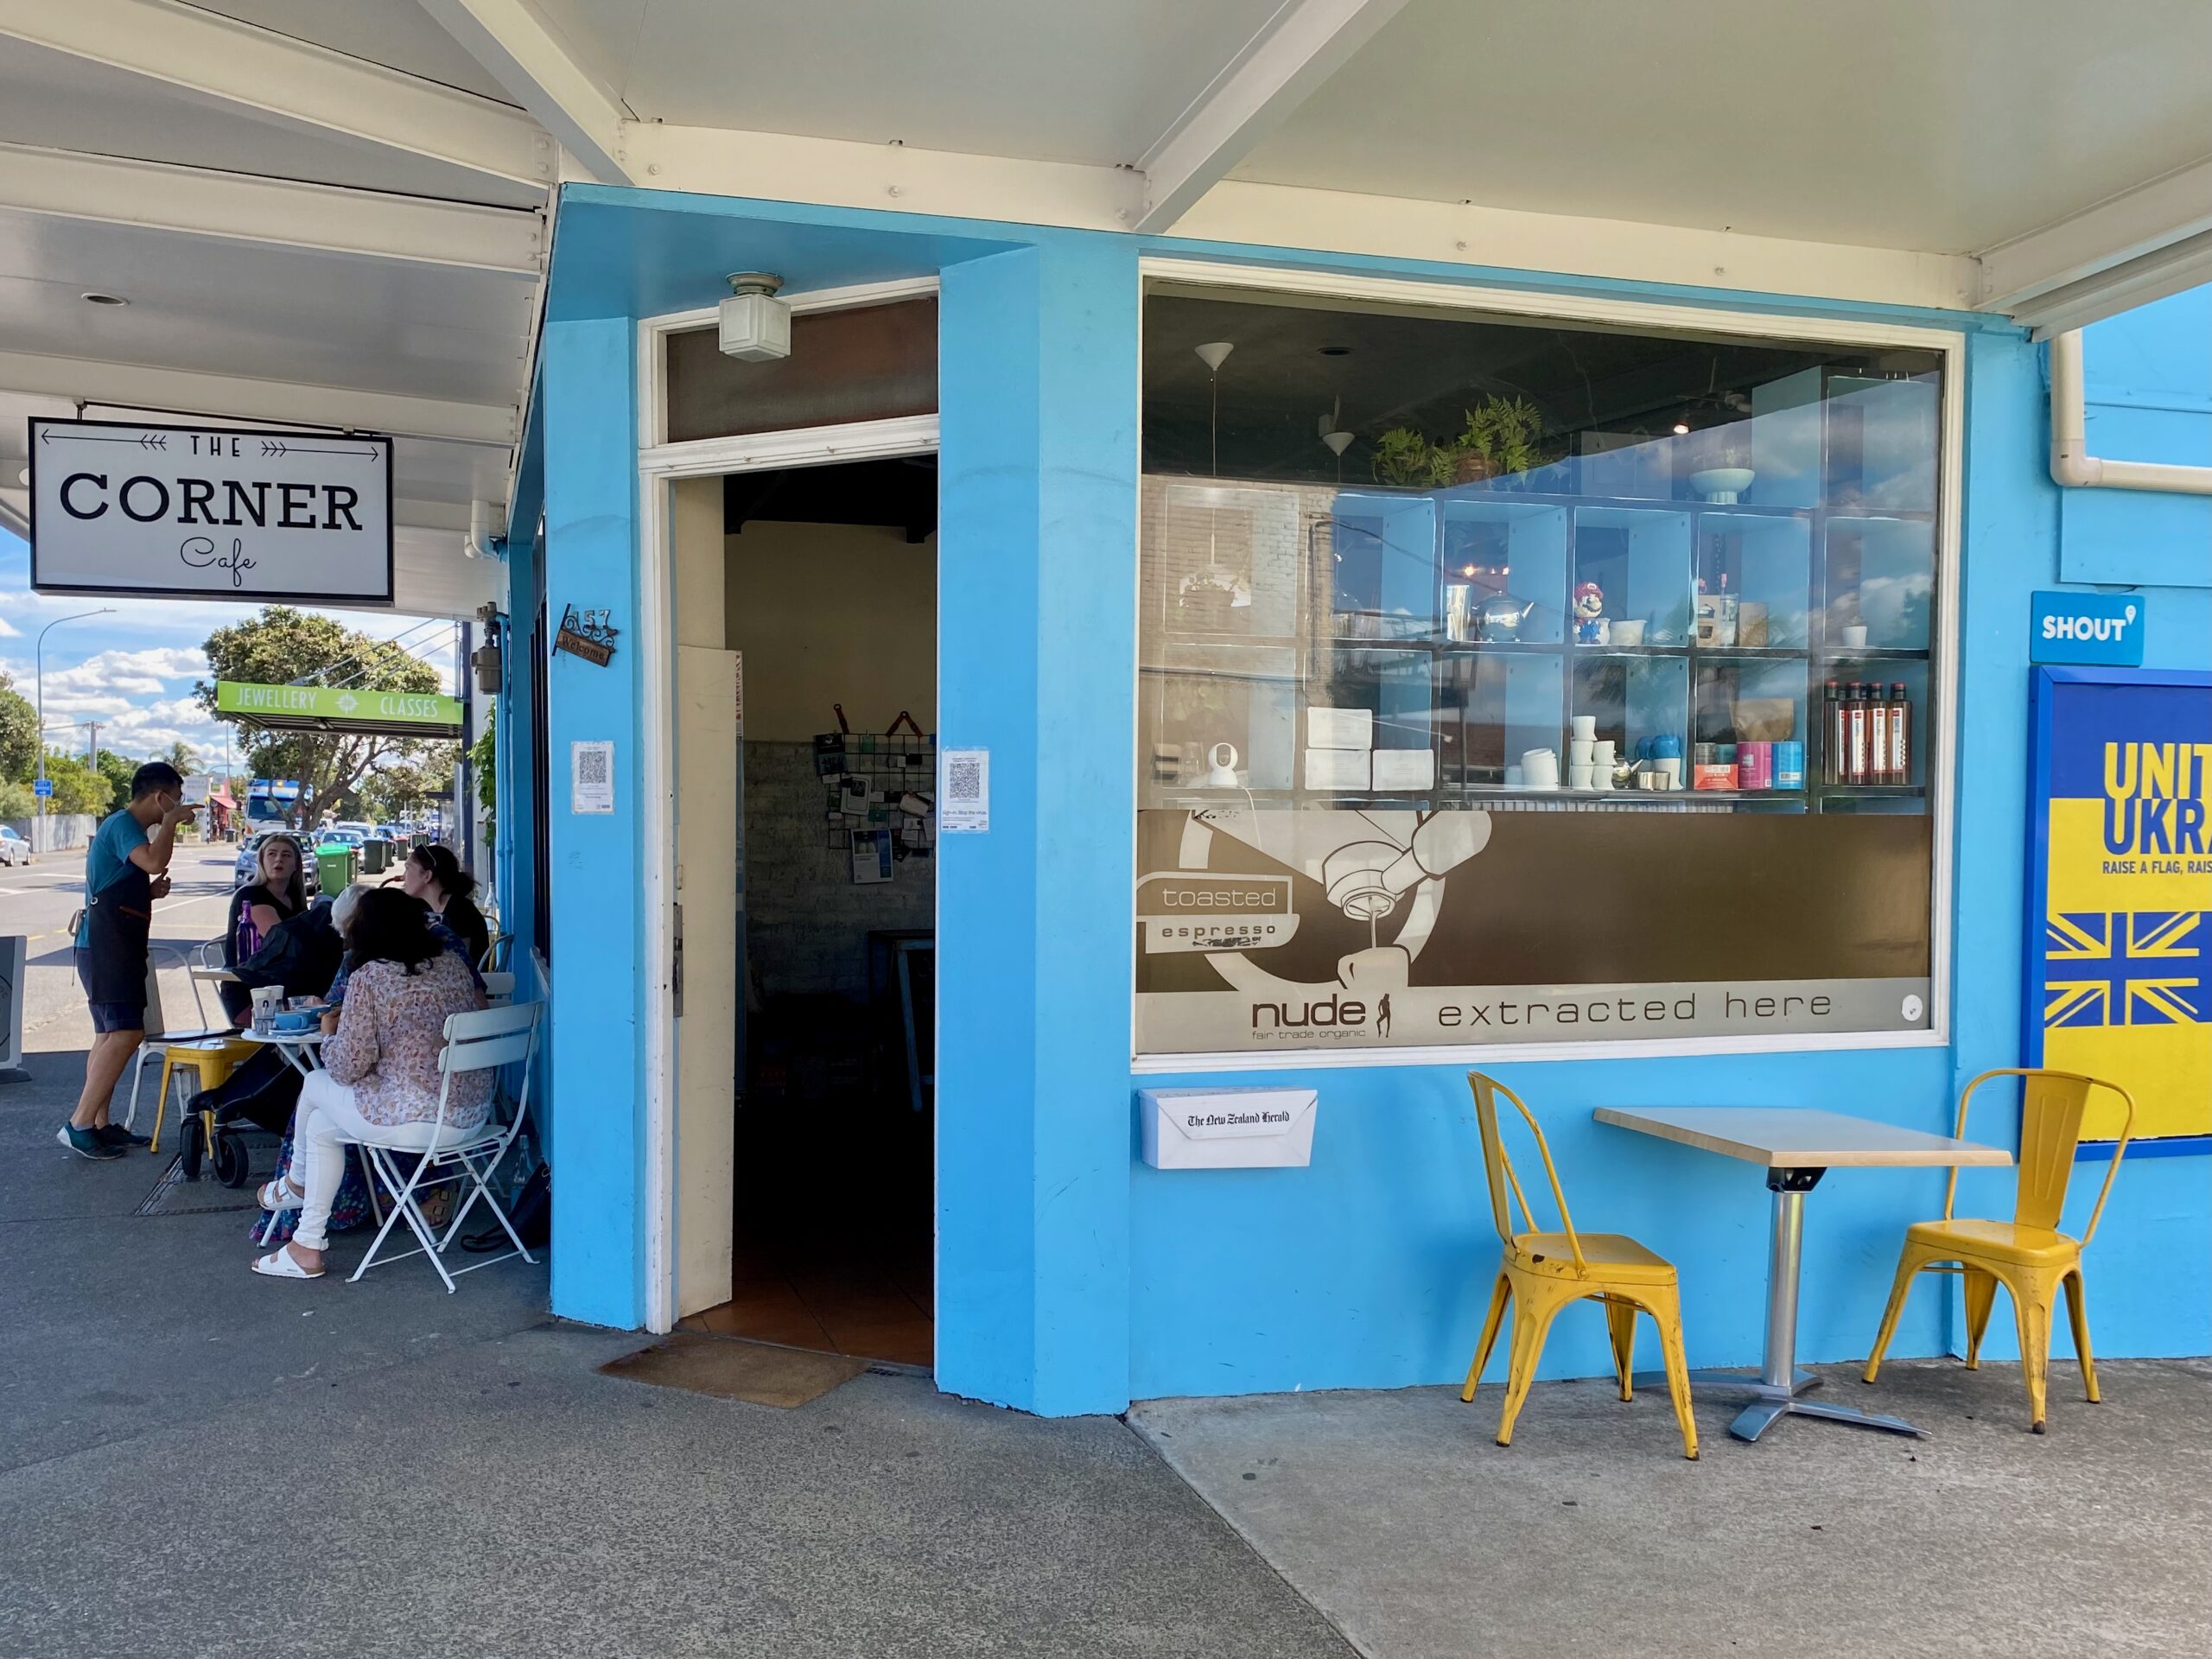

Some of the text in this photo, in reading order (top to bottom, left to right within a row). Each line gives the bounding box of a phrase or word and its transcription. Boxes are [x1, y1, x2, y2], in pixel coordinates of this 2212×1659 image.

[190, 435, 241, 457] THE
[60, 473, 363, 531] CORNER
[180, 537, 257, 588] Cafe
[2042, 615, 2126, 642] SHOUT
[562, 635, 605, 660] Welcome
[236, 688, 438, 718] JEWELLERY CLASSES
[2103, 798, 2212, 855] UKR
[2102, 861, 2136, 874] RAISE
[2139, 861, 2148, 874] A
[2152, 861, 2183, 875] FLAG,
[1162, 887, 1276, 906] toasted
[1161, 925, 1276, 940] espresso
[1252, 993, 1366, 1028] nude
[1438, 991, 1832, 1027] extracted here
[1252, 1030, 1366, 1040] fair trade organic
[1187, 1110, 1290, 1127] The New Zealand Herald
